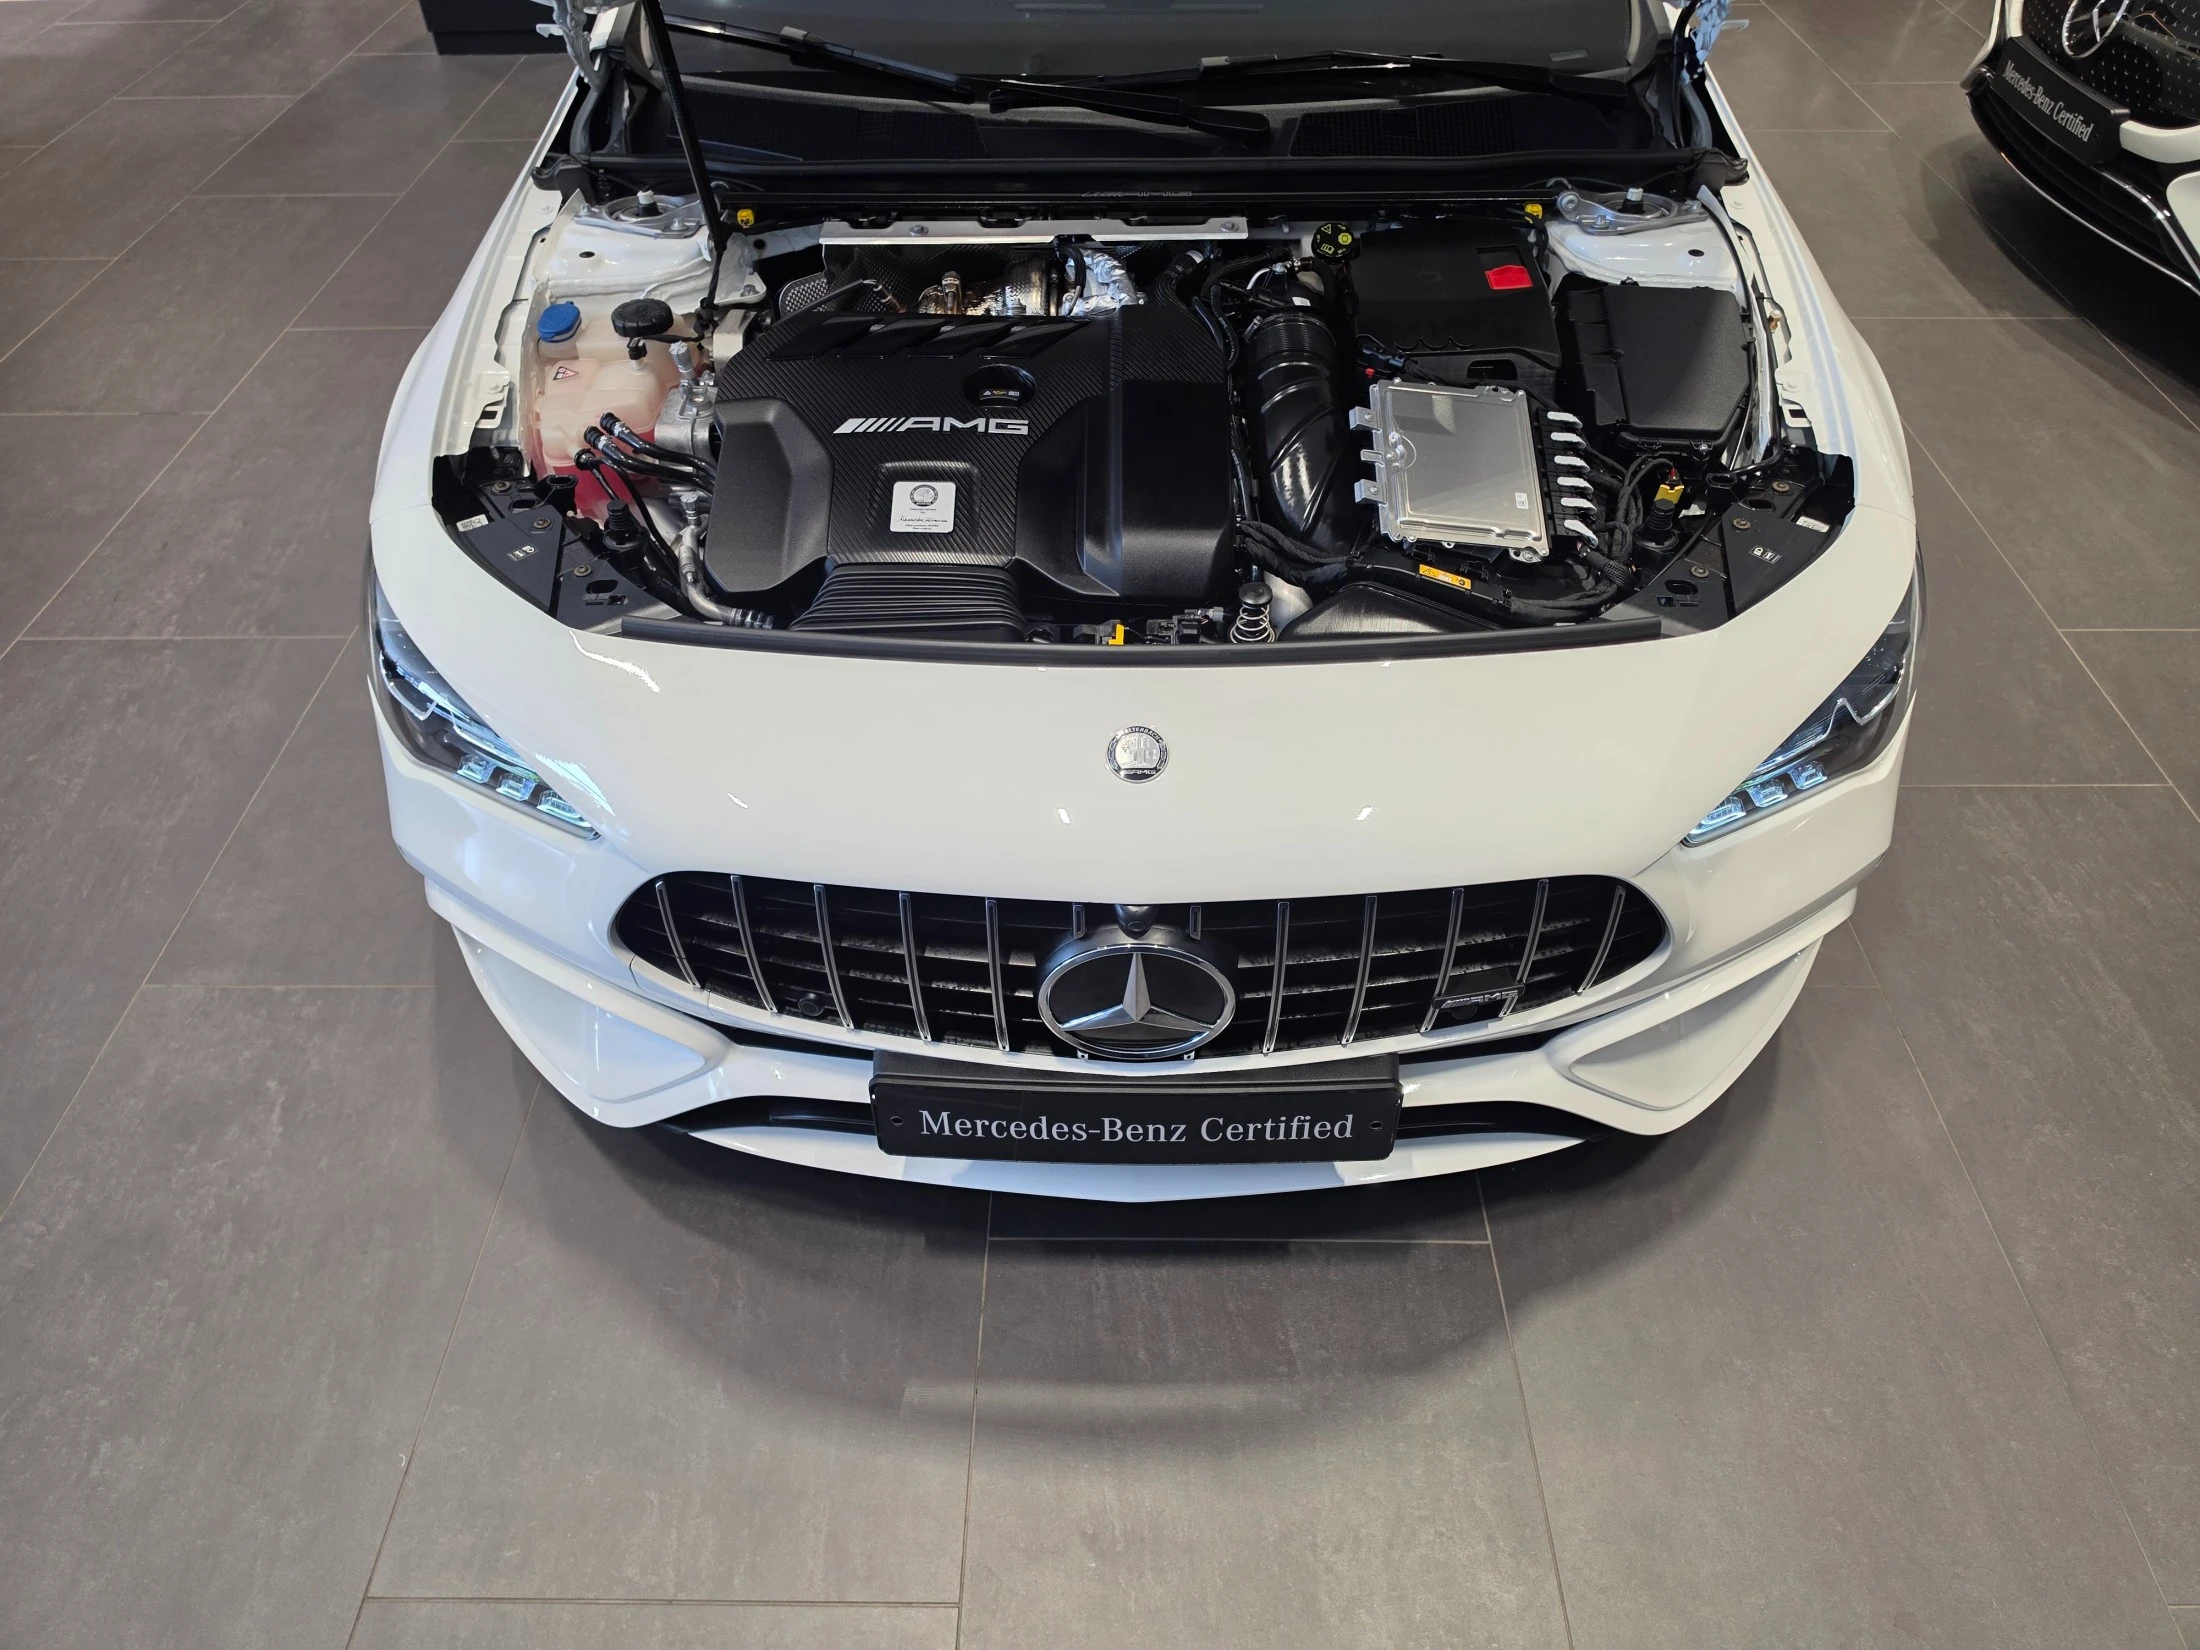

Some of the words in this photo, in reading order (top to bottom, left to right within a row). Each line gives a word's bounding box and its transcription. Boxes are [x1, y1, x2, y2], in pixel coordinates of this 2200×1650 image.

[2002, 60, 2055, 115] Mercedes-Benz
[2052, 101, 2094, 142] Certified
[919, 1109, 1187, 1143] Mercedes-Benz
[1200, 1114, 1354, 1143] Certified
